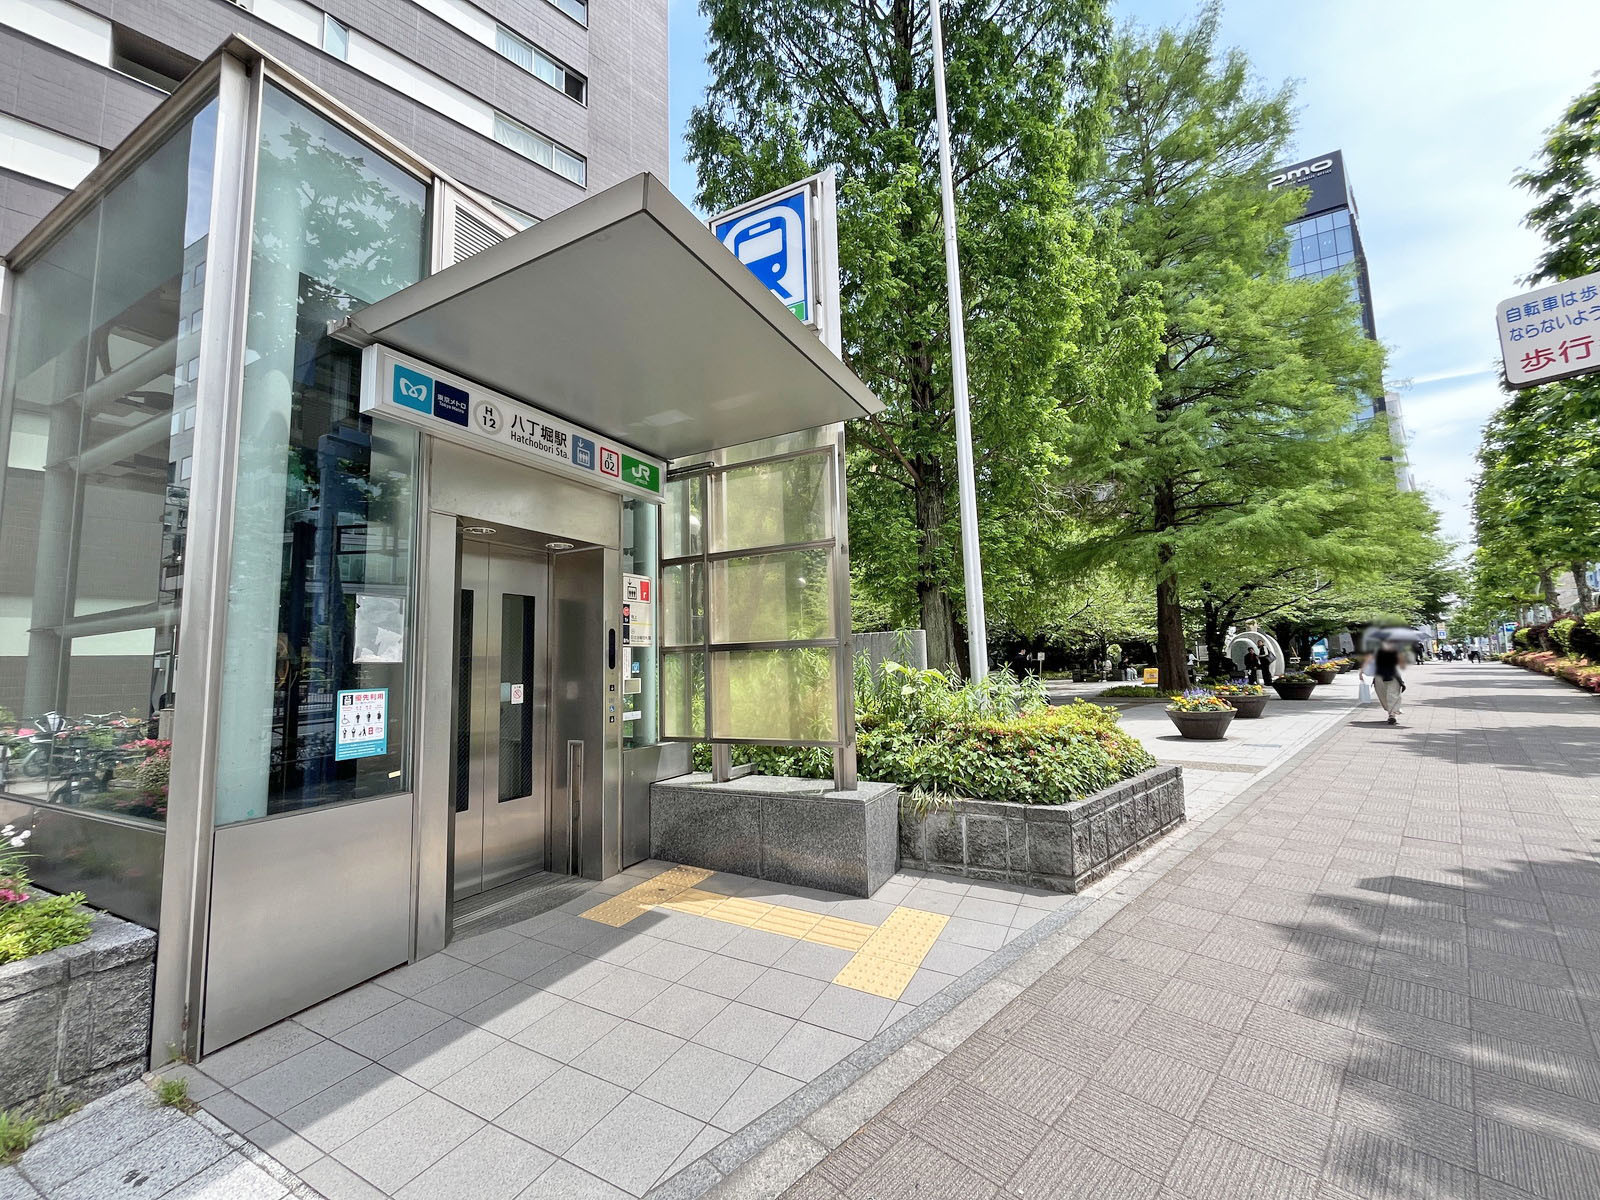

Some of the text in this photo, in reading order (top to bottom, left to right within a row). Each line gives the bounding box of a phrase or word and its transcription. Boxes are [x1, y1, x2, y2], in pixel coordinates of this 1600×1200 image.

[1268, 160, 1333, 191] pmo
[1506, 285, 1600, 323] 自転車は歩
[1520, 335, 1600, 373] 歩行
[437, 393, 467, 410] 東京メトロ
[439, 401, 465, 414] Tokyo Metro
[485, 406, 493, 417] H
[483, 415, 496, 429] 12
[511, 414, 567, 448] 八丁堀駅
[510, 430, 570, 460] Hatchobori Sta.
[606, 452, 613, 461] JE
[604, 460, 615, 472] 02
[631, 464, 651, 482] JR
[355, 693, 384, 702] 優先利用
